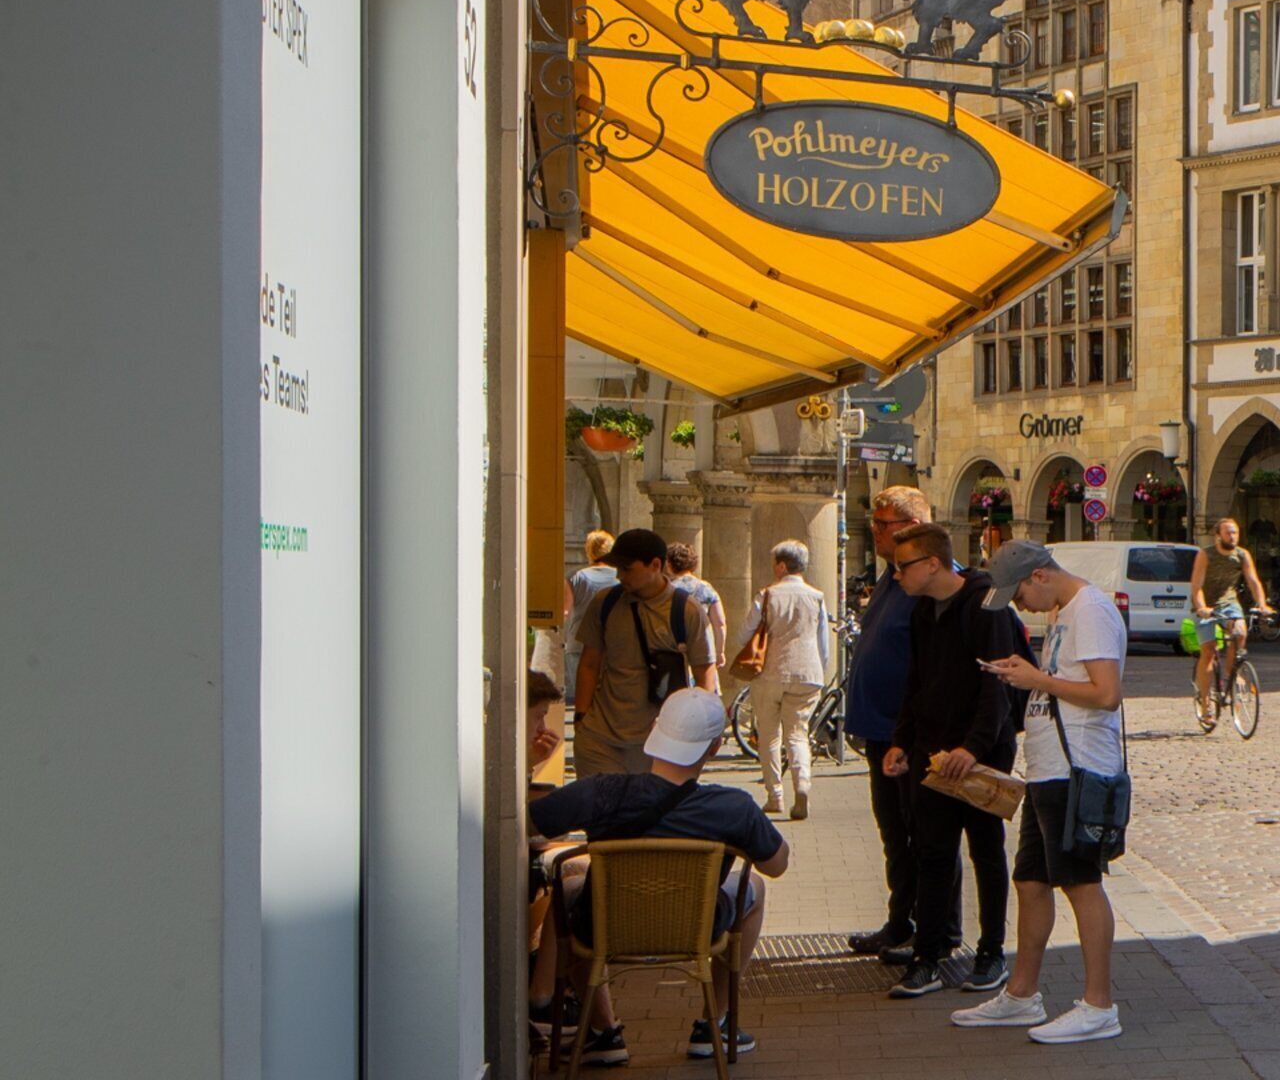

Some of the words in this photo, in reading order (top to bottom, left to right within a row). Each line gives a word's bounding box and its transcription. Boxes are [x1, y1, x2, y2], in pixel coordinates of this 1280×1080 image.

[749, 119, 950, 174] Pohlmeyers
[757, 172, 944, 217] HOLZOFEN
[277, 282, 297, 339] Teil
[272, 354, 309, 415] Teams!
